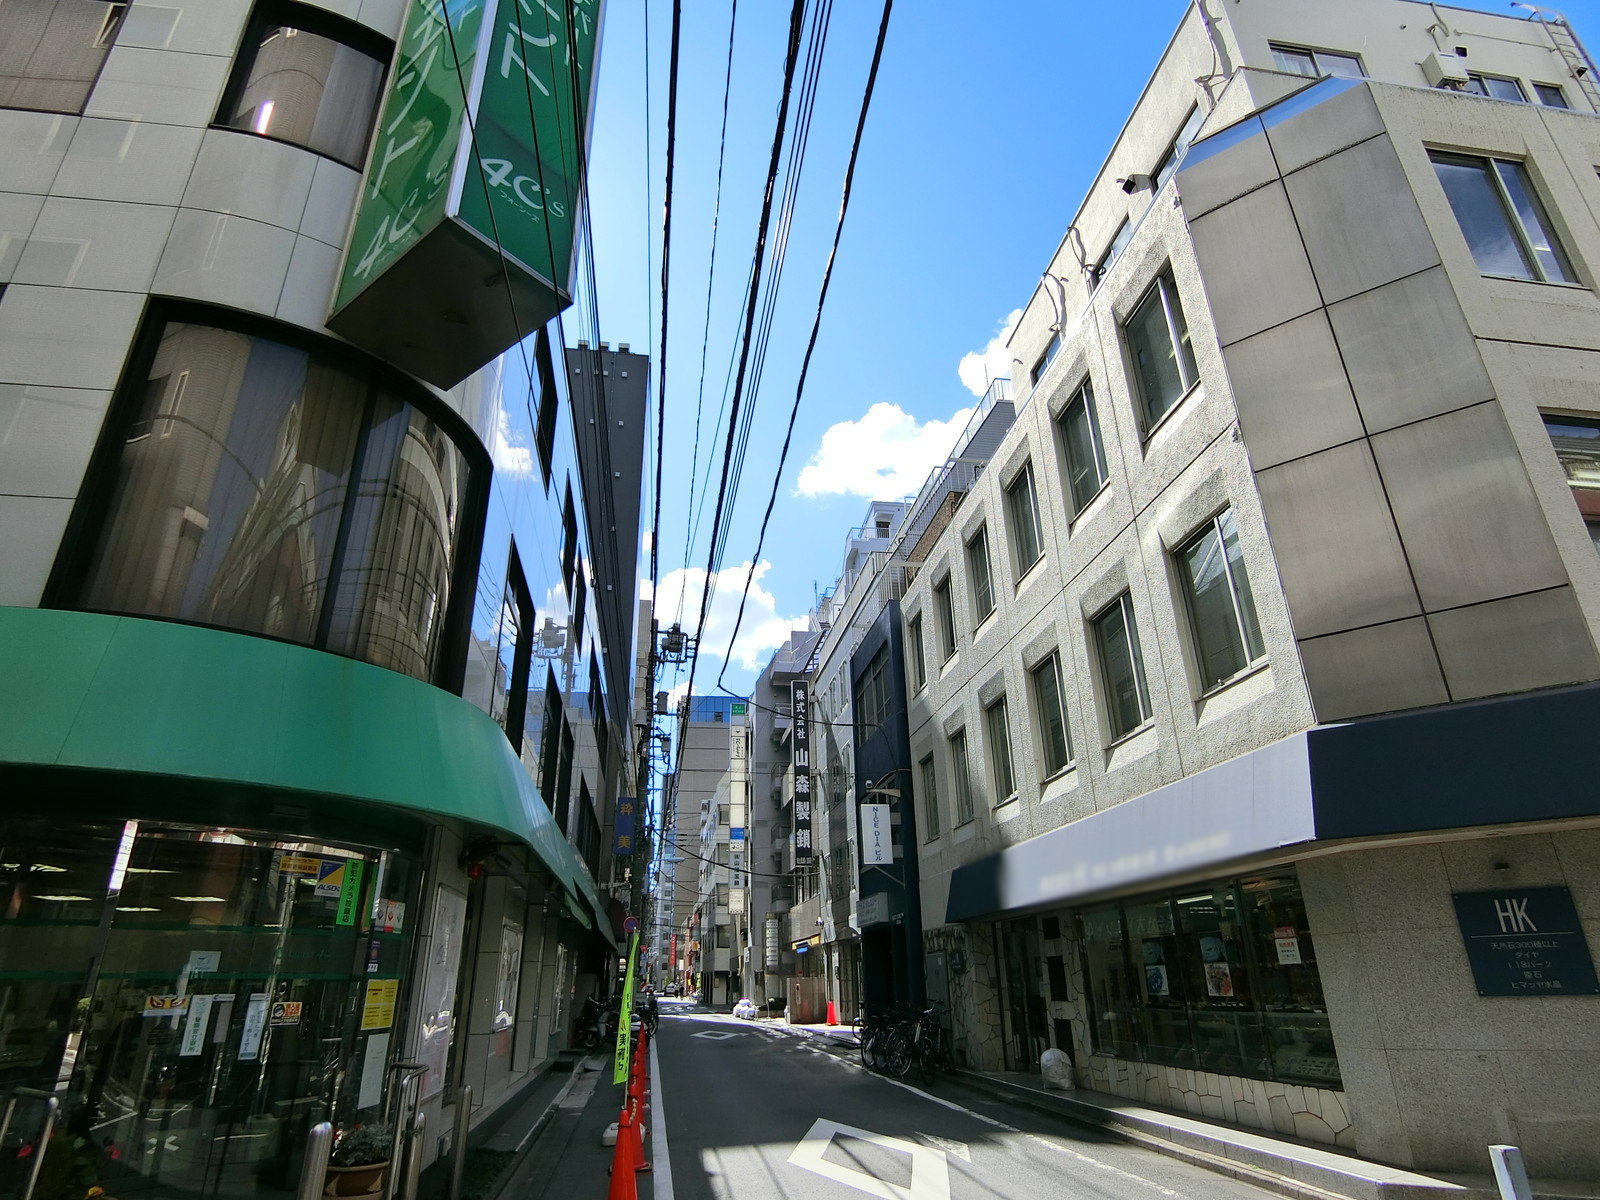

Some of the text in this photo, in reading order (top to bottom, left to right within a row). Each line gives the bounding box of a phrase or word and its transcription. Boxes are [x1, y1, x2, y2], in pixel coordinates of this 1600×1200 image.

[796, 689, 807, 739] 株式会社
[795, 748, 811, 849] 山森製鎖
[875, 849, 883, 861] ビル
[342, 861, 359, 923] 防犯カメラ設置店
[1493, 898, 1538, 933] HK
